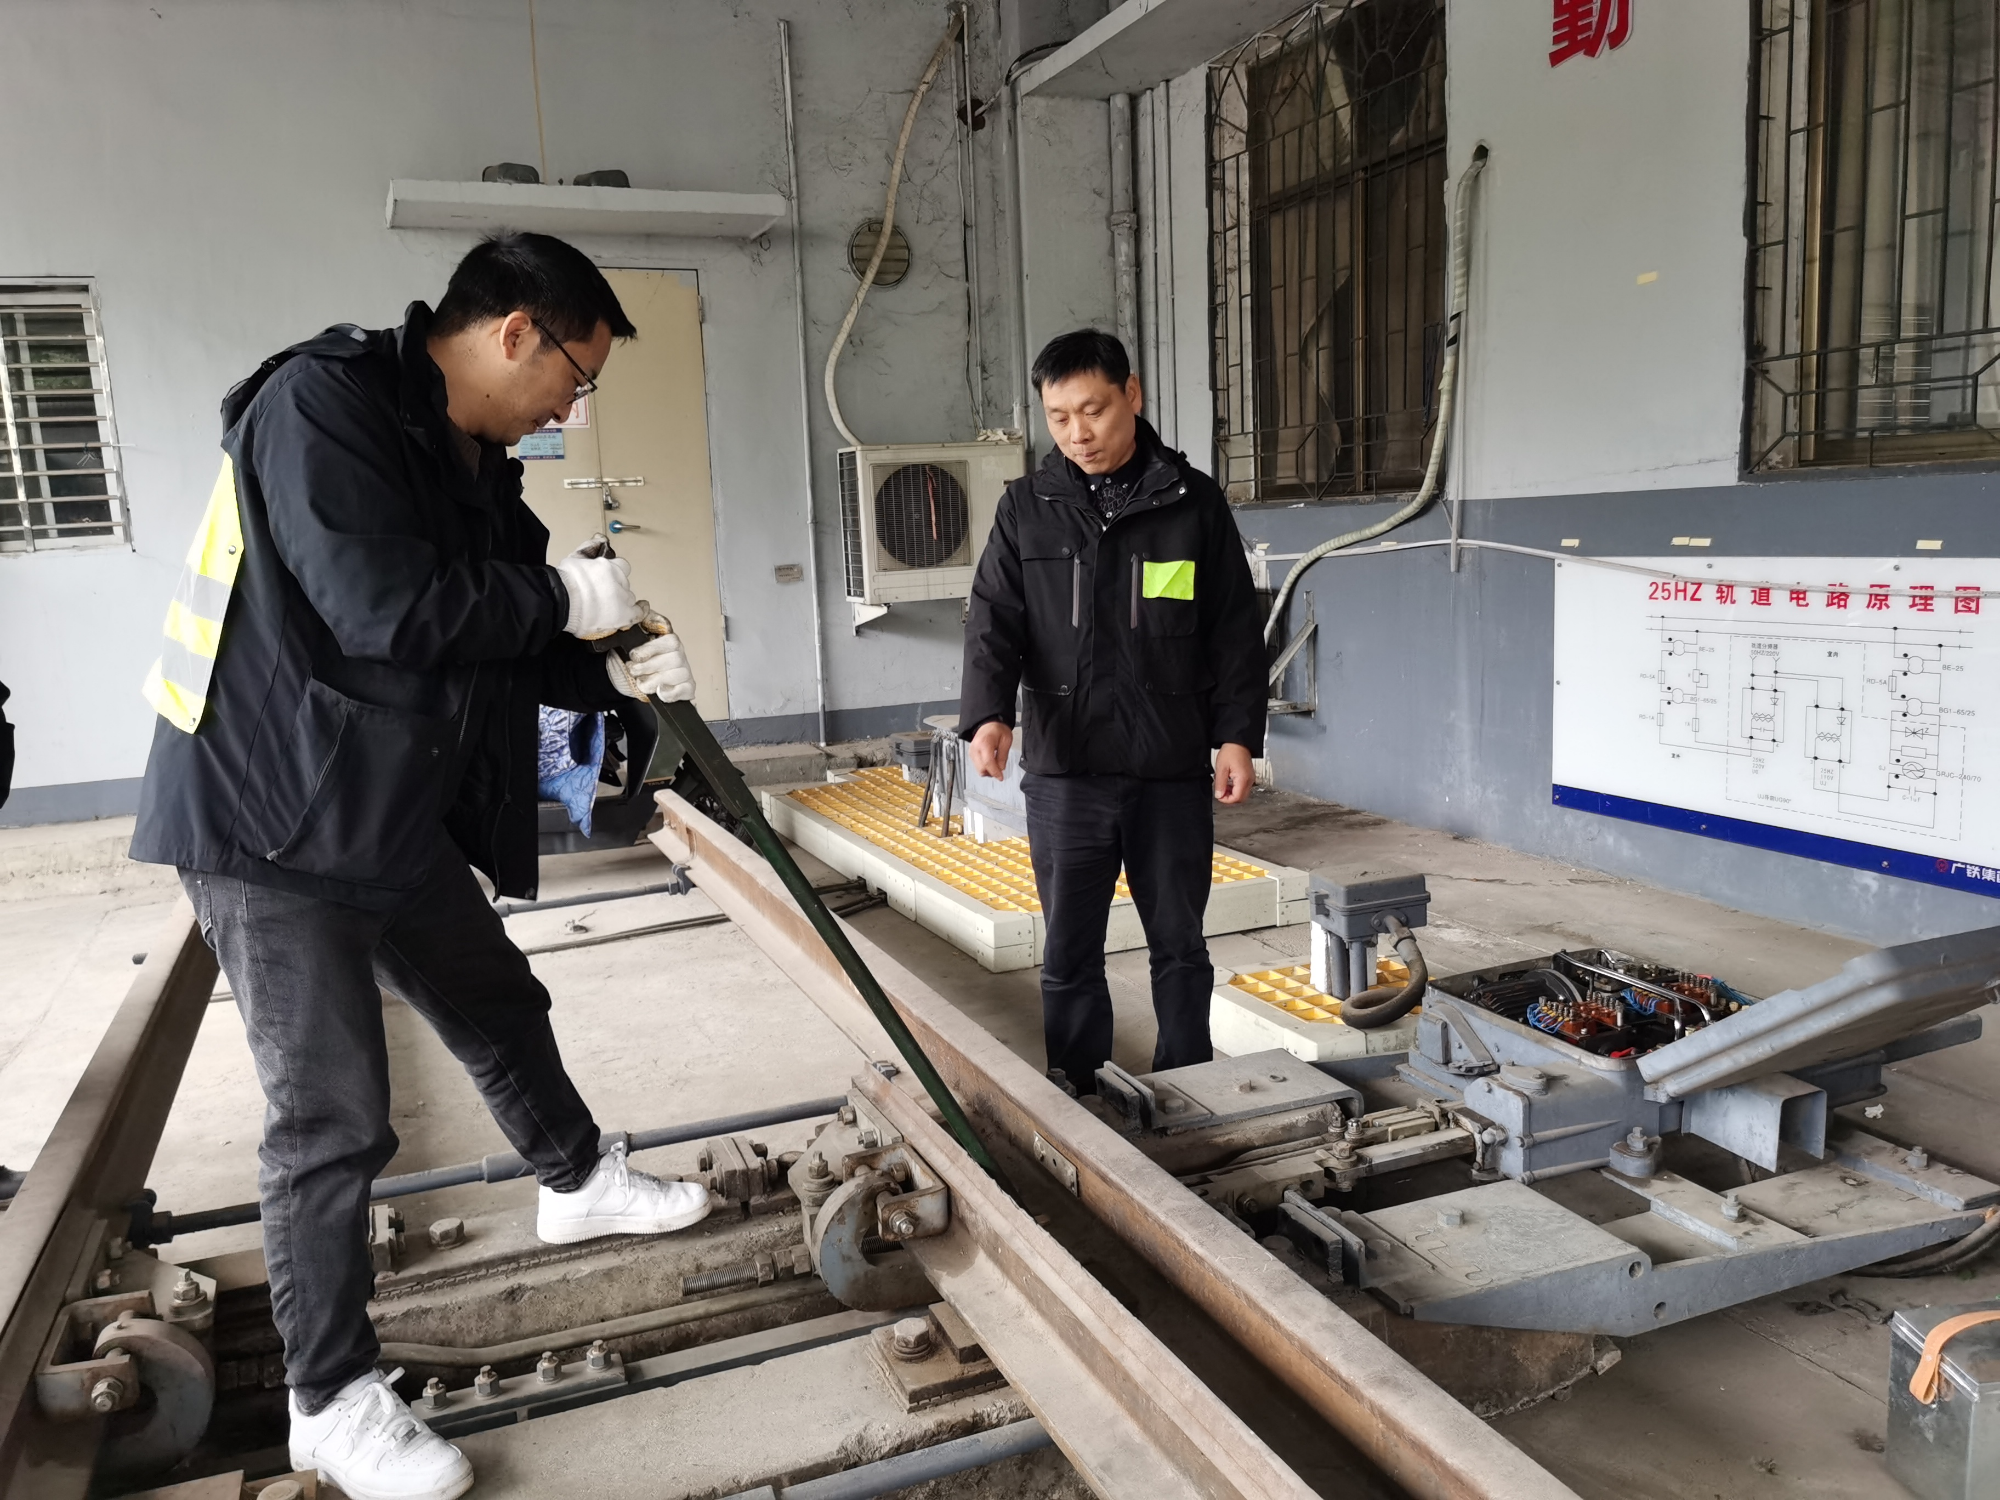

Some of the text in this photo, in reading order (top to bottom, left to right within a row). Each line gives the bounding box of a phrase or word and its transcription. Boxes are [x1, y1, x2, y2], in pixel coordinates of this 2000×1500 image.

[1648, 581, 1982, 615] 25HZ 轨道电路原理图
[1941, 664, 1964, 672] BE-25
[1866, 677, 1888, 686] RD-5A
[1938, 707, 1976, 717] BG1-65/25
